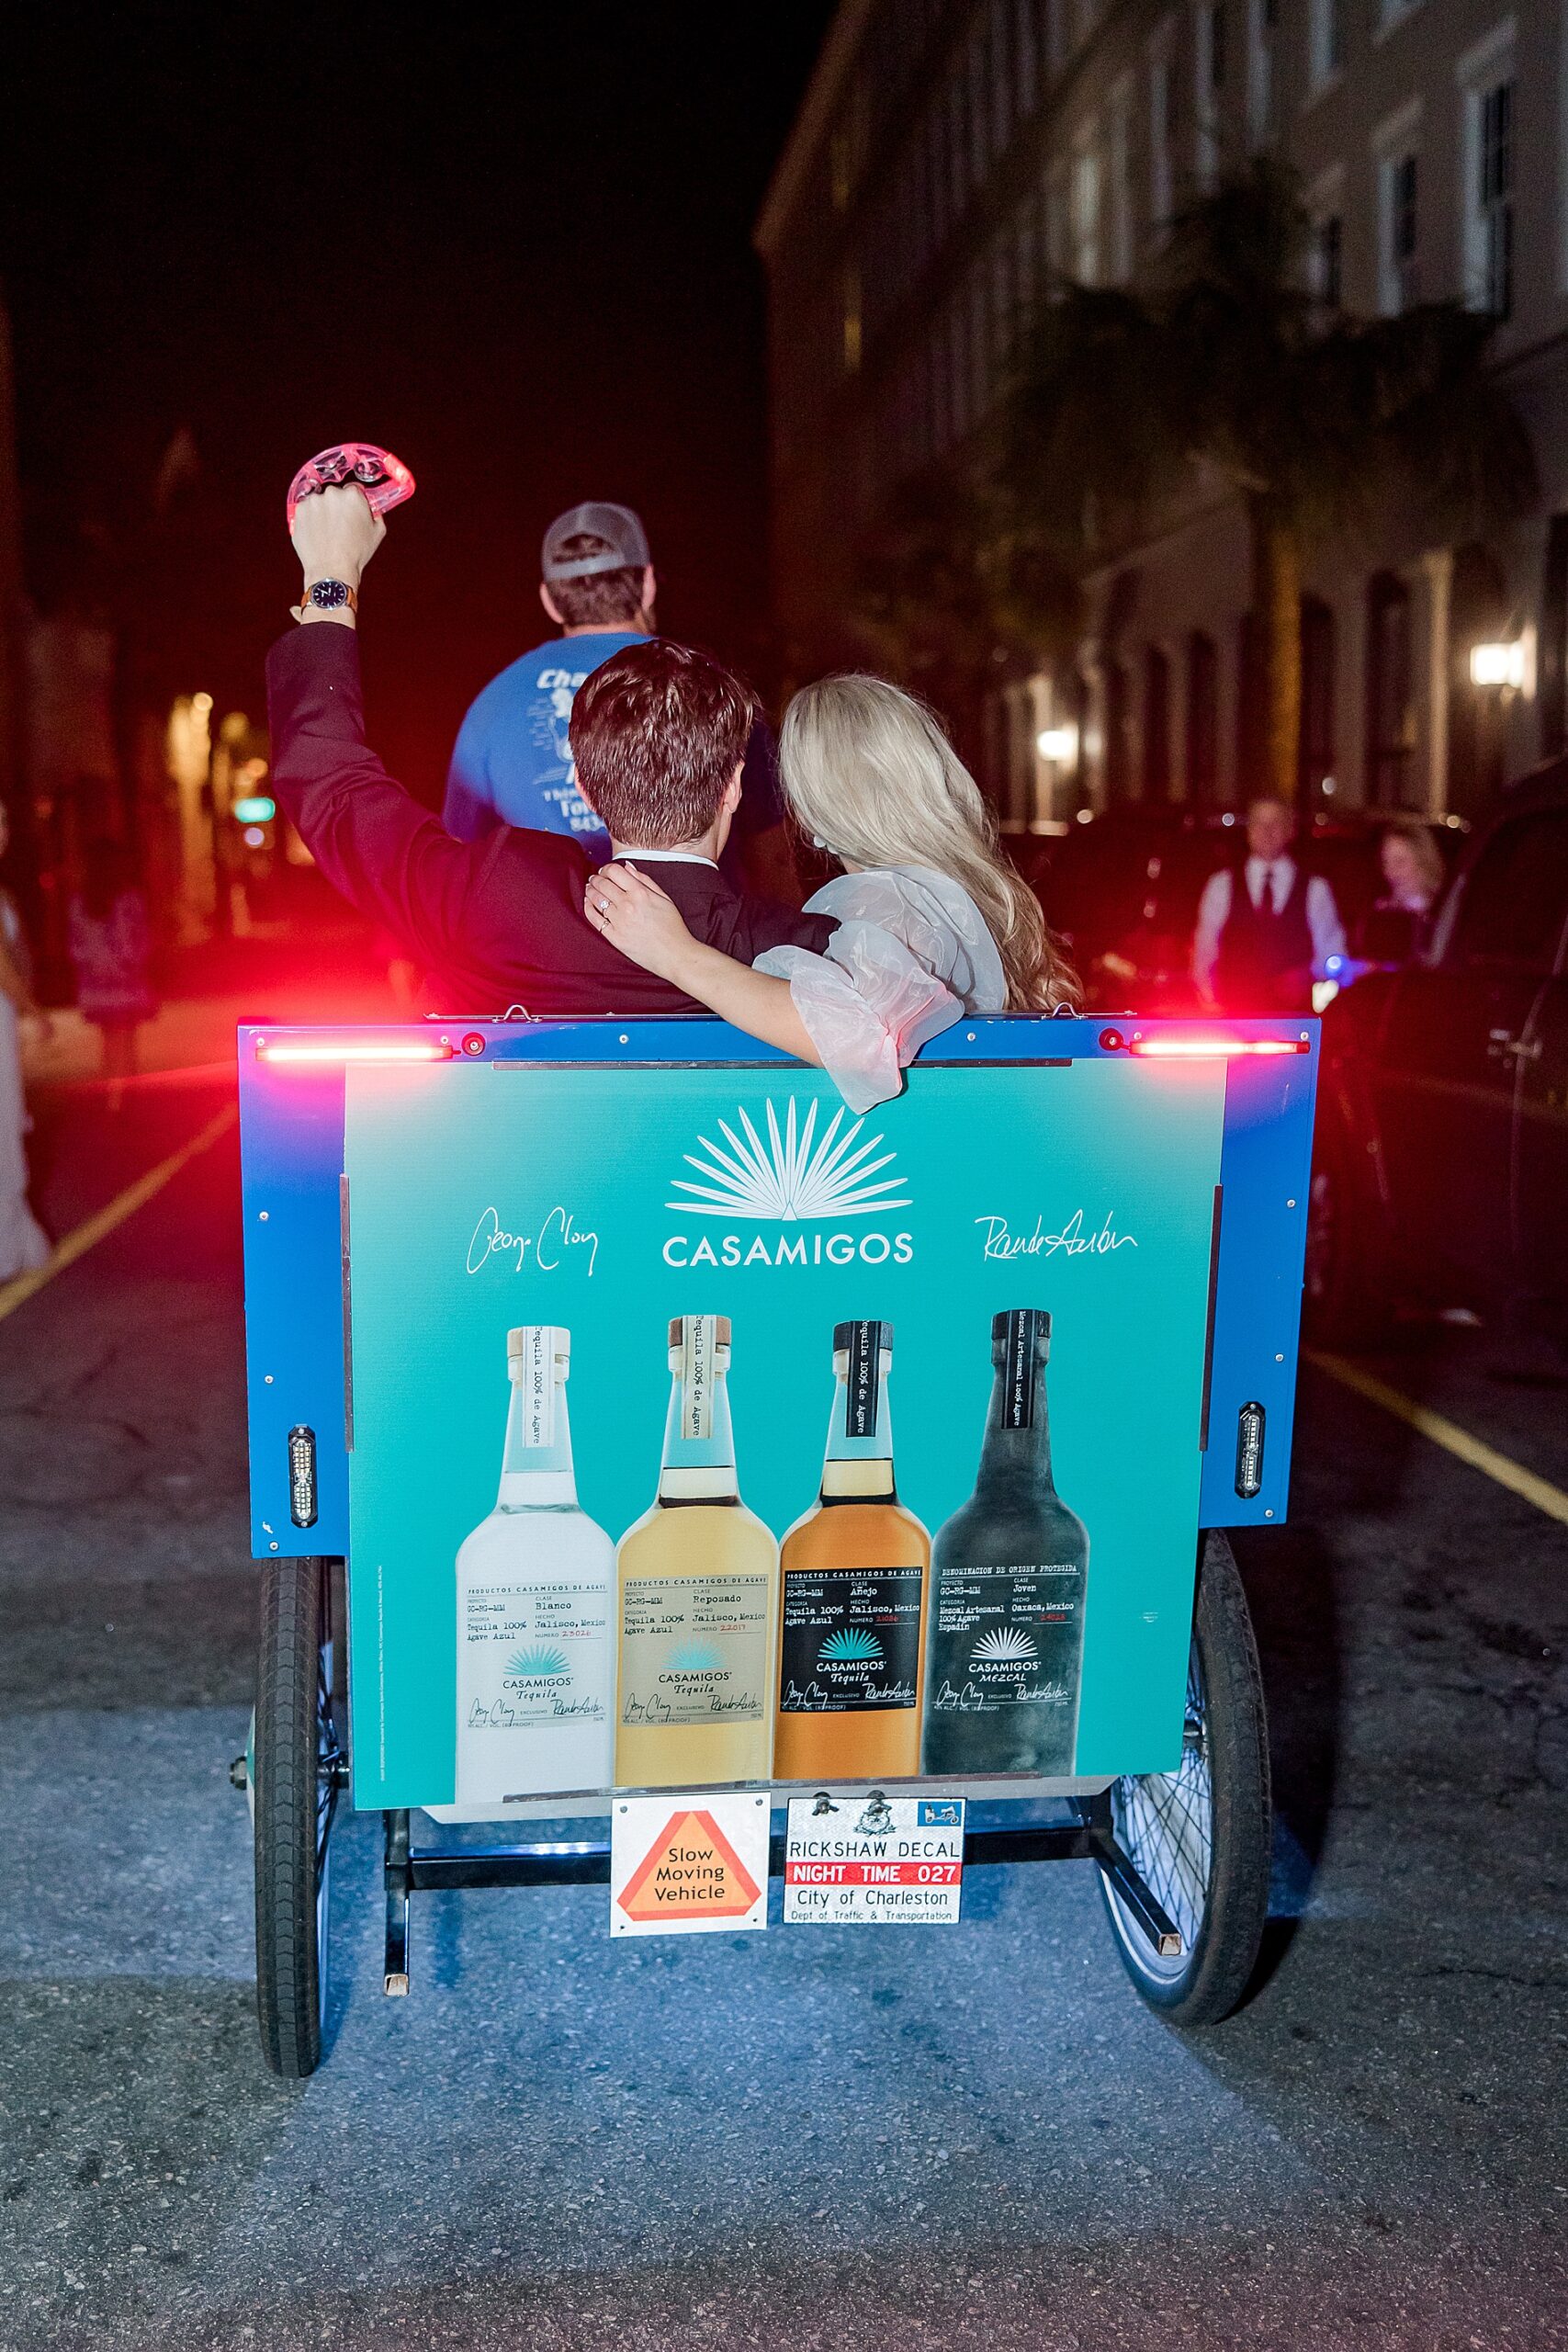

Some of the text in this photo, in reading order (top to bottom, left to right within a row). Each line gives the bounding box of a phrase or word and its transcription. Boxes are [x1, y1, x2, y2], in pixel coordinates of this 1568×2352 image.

[662, 1233, 913, 1267] CASAMIGOS
[694, 1362, 703, 1385] 100%
[856, 1320, 869, 1433] equila 100% de Agave
[535, 1371, 543, 1394] 100%
[694, 1390, 702, 1401] de
[1015, 1384, 1023, 1401] 100%
[535, 1398, 543, 1410] de
[1013, 1404, 1021, 1426] Agave
[692, 1407, 702, 1436] Agave
[532, 1416, 541, 1443] Agave
[851, 1586, 877, 1597] Añejo
[694, 1596, 741, 1604] Reposado
[785, 1606, 843, 1616] Tequila 100%
[850, 1606, 892, 1614] Jalisco,
[940, 1605, 1005, 1614] Mezcal Artesanal
[535, 1620, 579, 1628] Jalisco,
[625, 1614, 684, 1625] Tequila 100%
[693, 1614, 738, 1623] Jalisco,
[785, 1618, 806, 1626] Agave
[939, 1614, 980, 1623] 100% Agave
[468, 1621, 527, 1632] Tequila 100%
[625, 1627, 645, 1635] Agave
[468, 1634, 489, 1642] Agave
[817, 1661, 884, 1672] CASAMIGOS
[969, 1661, 1038, 1672] CASAMIGOS
[659, 1672, 729, 1683] CASAMIGOS
[830, 1674, 869, 1685] Tequila
[979, 1674, 1027, 1682] MEZCAL
[503, 1678, 572, 1689] CASAMIGOS
[674, 1684, 715, 1696] Tequila
[516, 1690, 558, 1702] Tequila
[669, 1848, 714, 1863] Slow
[790, 1842, 960, 1858] RICKSHAW DECAL
[656, 1866, 724, 1882] Moving
[793, 1866, 956, 1883] NIGHT TIME 027
[654, 1885, 725, 1901] Vehicle
[797, 1890, 948, 1907] City of Charleston
[791, 1910, 952, 1923] Dept of Traffic & Transportation
